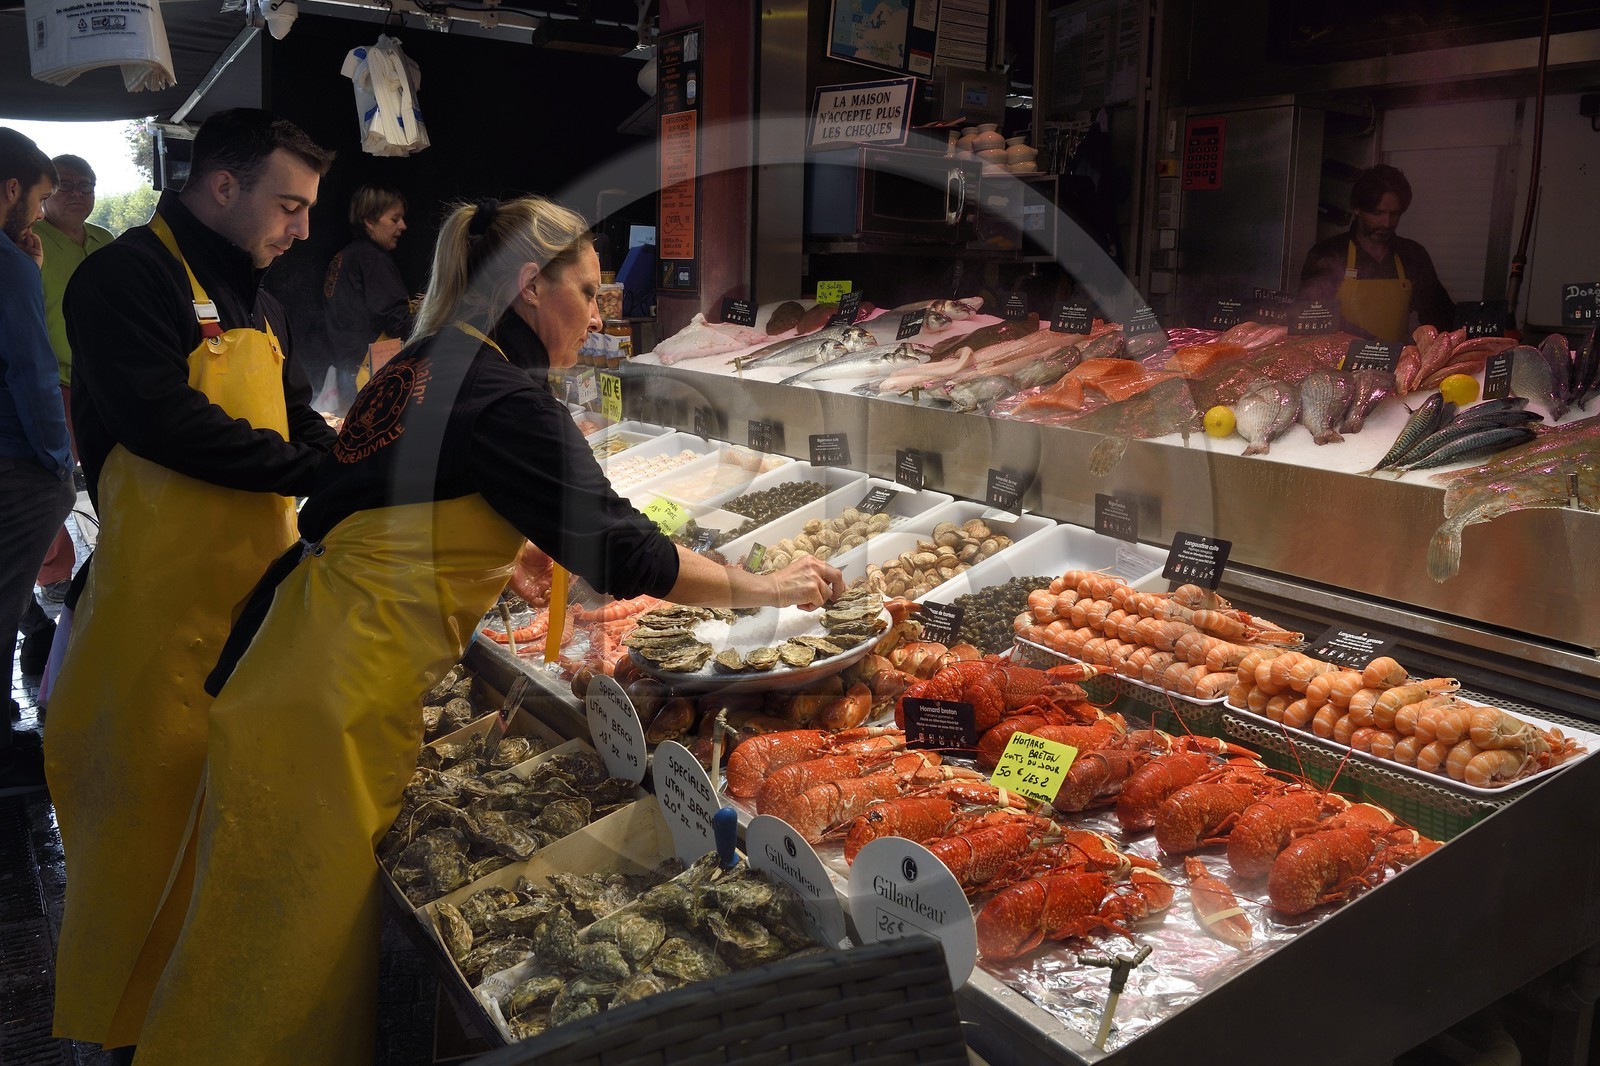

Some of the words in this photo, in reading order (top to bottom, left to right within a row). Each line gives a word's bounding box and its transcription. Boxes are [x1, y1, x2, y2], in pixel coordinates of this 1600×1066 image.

[834, 96, 846, 108] LA
[852, 92, 892, 107] MAISON
[819, 109, 872, 124] N'ACCEPTE
[876, 106, 901, 119] PLUS
[823, 127, 841, 139] LES
[846, 122, 893, 137] CHEQUES
[602, 376, 612, 397] 20
[614, 381, 621, 400] €
[919, 706, 940, 714] Homard
[941, 707, 958, 715] breton
[590, 698, 608, 723] UTAH
[612, 720, 633, 746] BEACH
[1028, 749, 1061, 763] BRETON
[996, 766, 1011, 777] 50
[1017, 768, 1024, 776] €
[1022, 772, 1039, 785] LES
[1040, 777, 1050, 788] 2
[665, 776, 685, 801] UTAH
[687, 797, 714, 828] BEACH
[765, 844, 820, 898] Gillardeau
[873, 875, 945, 926] Gillardeau
